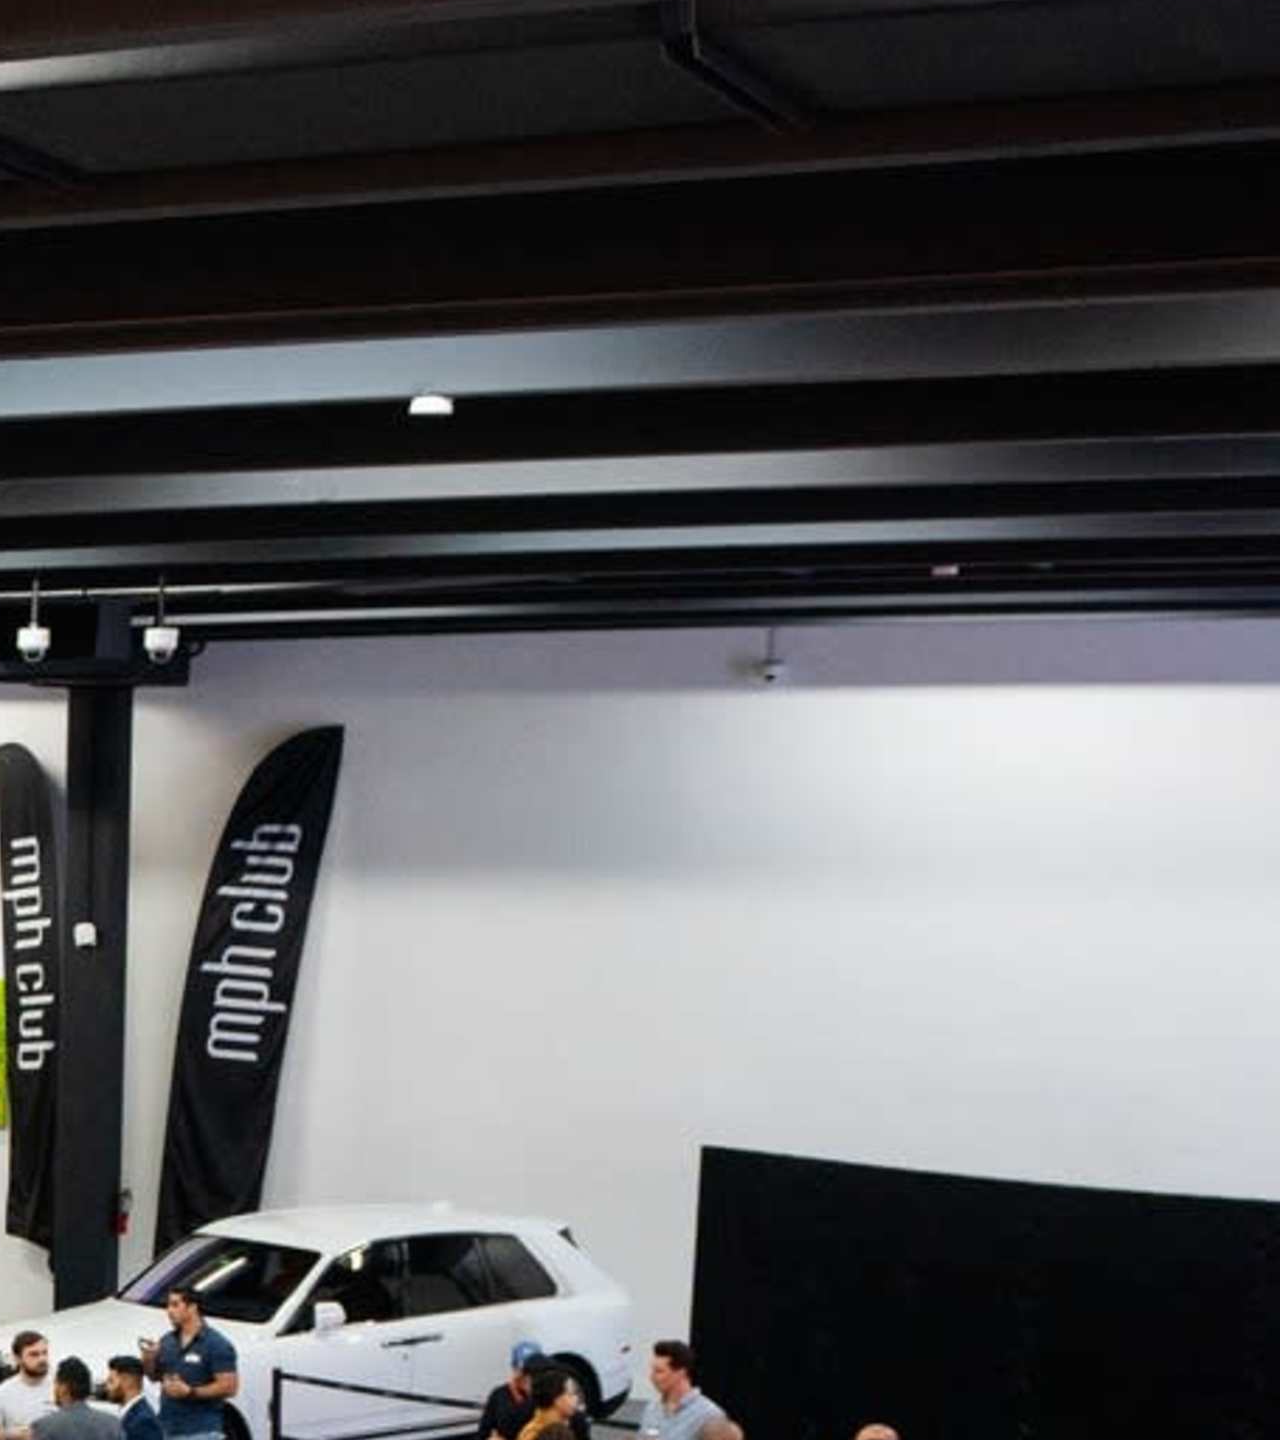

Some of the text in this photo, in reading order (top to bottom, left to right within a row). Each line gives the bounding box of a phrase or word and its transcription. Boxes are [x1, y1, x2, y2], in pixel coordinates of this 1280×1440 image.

[2, 835, 56, 1071] mph club
[199, 823, 303, 1062] mph club
